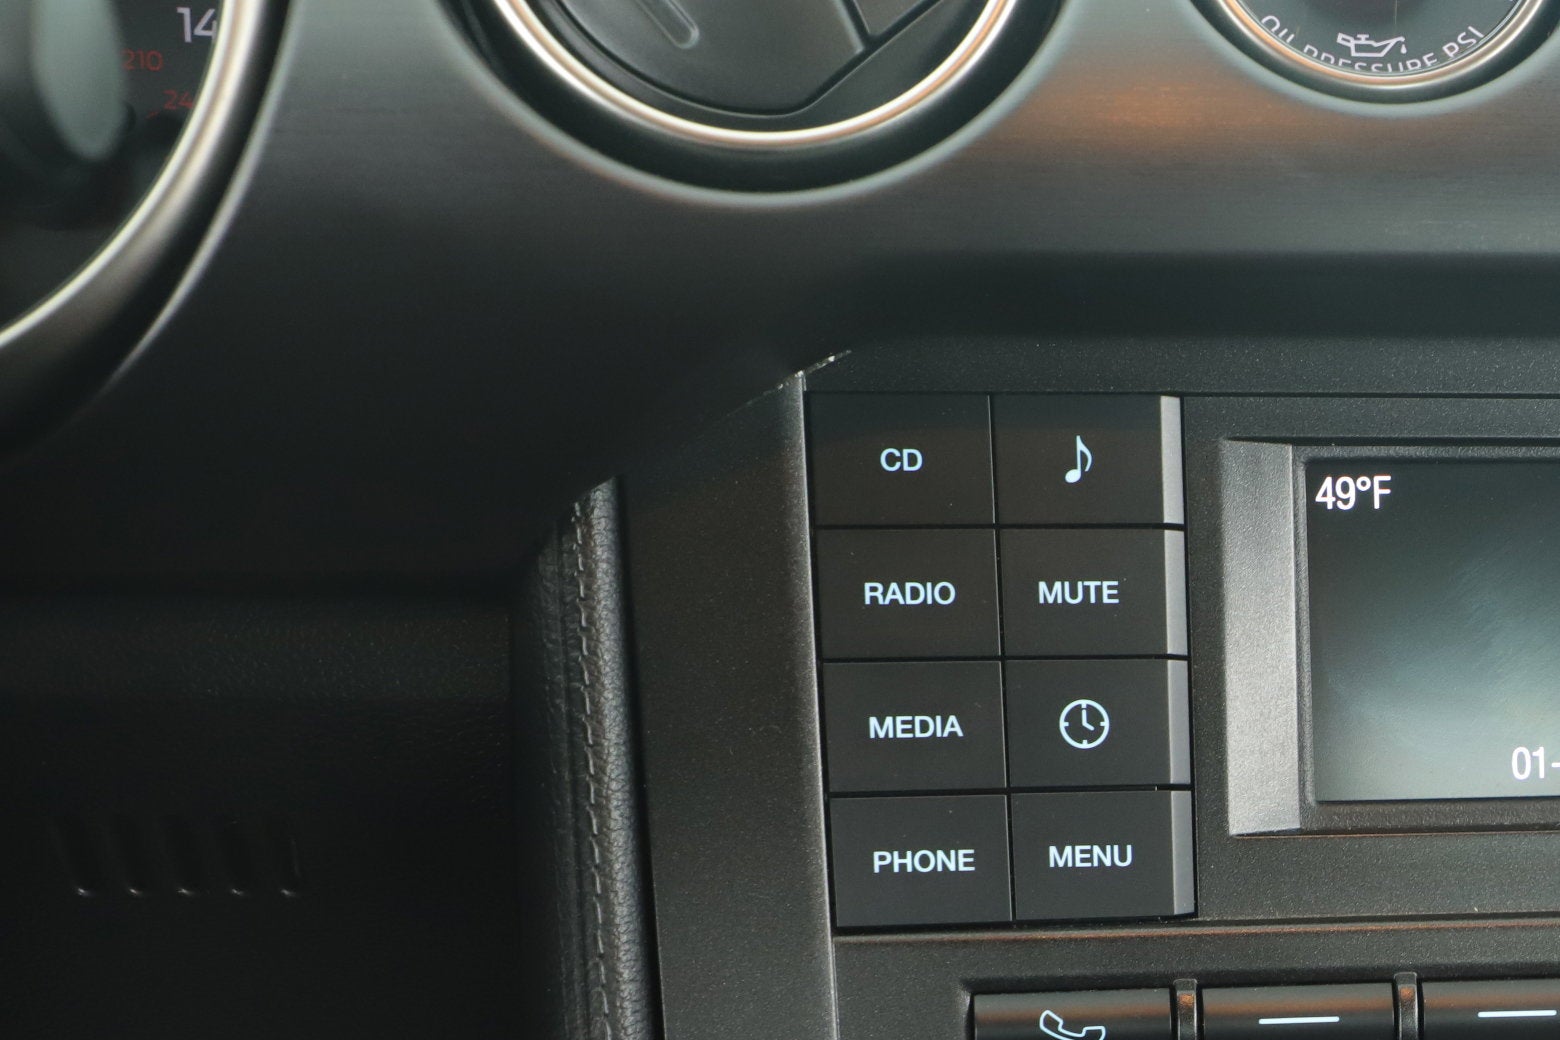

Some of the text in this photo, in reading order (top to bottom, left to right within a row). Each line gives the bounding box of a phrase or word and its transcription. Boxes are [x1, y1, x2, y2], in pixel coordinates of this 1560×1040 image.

[1441, 24, 1485, 60] PSI
[122, 49, 164, 72] 210
[879, 446, 924, 473] CD
[1314, 474, 1393, 511] 49°F
[863, 580, 957, 606] RADIO
[1037, 579, 1121, 606] MUTE
[868, 713, 965, 740] MEDIA
[872, 848, 977, 875] PHONE
[1048, 843, 1133, 869] MENU
